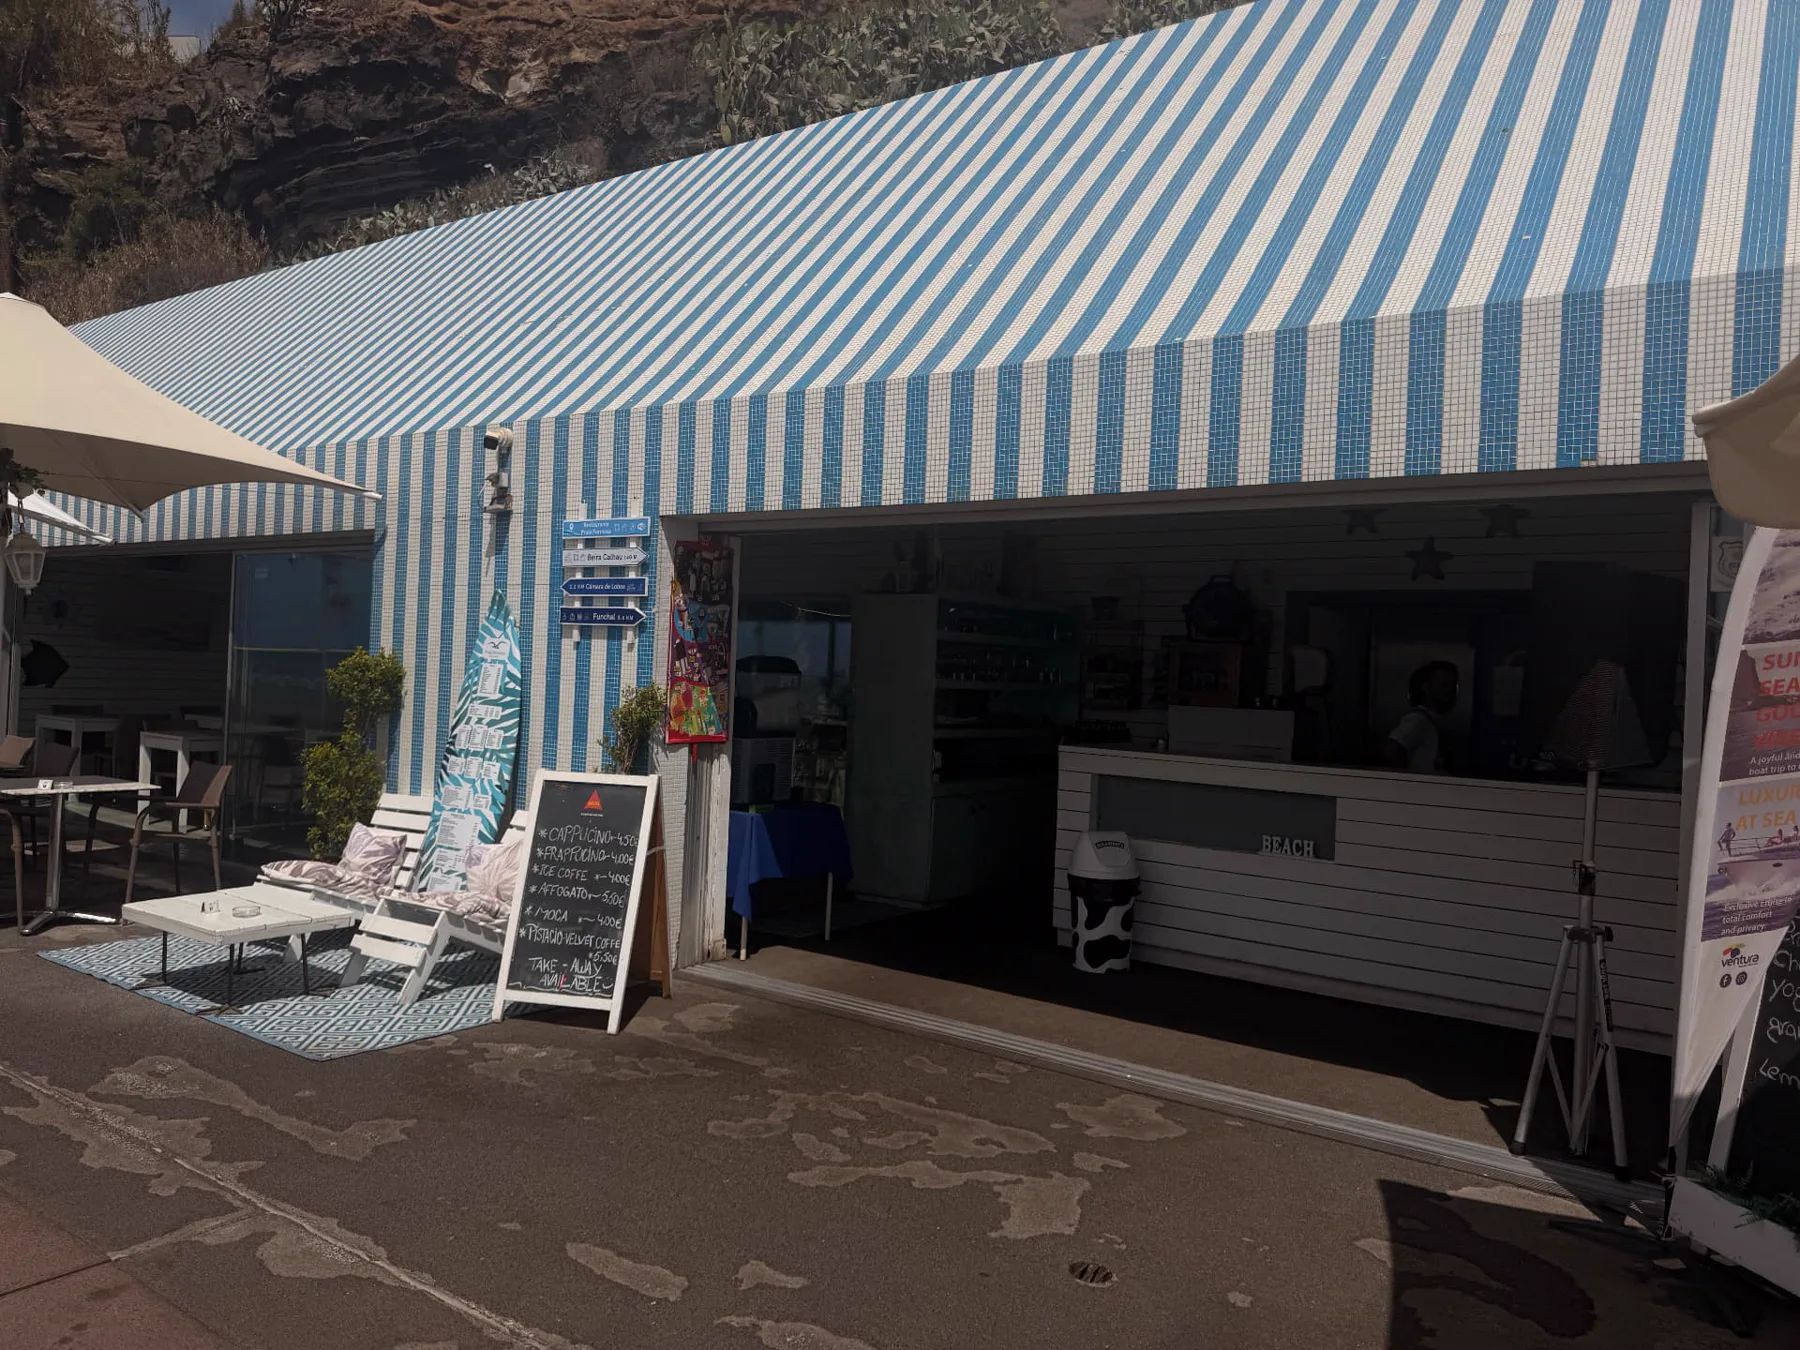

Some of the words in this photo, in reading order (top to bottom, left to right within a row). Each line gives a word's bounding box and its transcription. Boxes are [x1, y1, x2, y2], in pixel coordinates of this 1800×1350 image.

[593, 612, 616, 621] Funchal
[1750, 756, 1757, 764] A
[1757, 752, 1783, 766] joyful
[1748, 766, 1768, 776] boat
[1770, 764, 1785, 774] trip
[1787, 763, 1796, 772] to
[1735, 814, 1759, 831] AT
[1762, 809, 1797, 828] SEA
[1261, 834, 1315, 858] BEACH
[538, 863, 557, 877] ICE
[557, 867, 588, 881] COFFE
[538, 881, 589, 900] AFFOGATO
[534, 906, 569, 923] MOCA
[1722, 913, 1741, 925] total
[1741, 909, 1773, 921] comfort
[595, 936, 621, 950] COFFE
[528, 956, 559, 974] TAKE
[570, 956, 603, 978] AWAY
[1721, 953, 1760, 968] ventura
